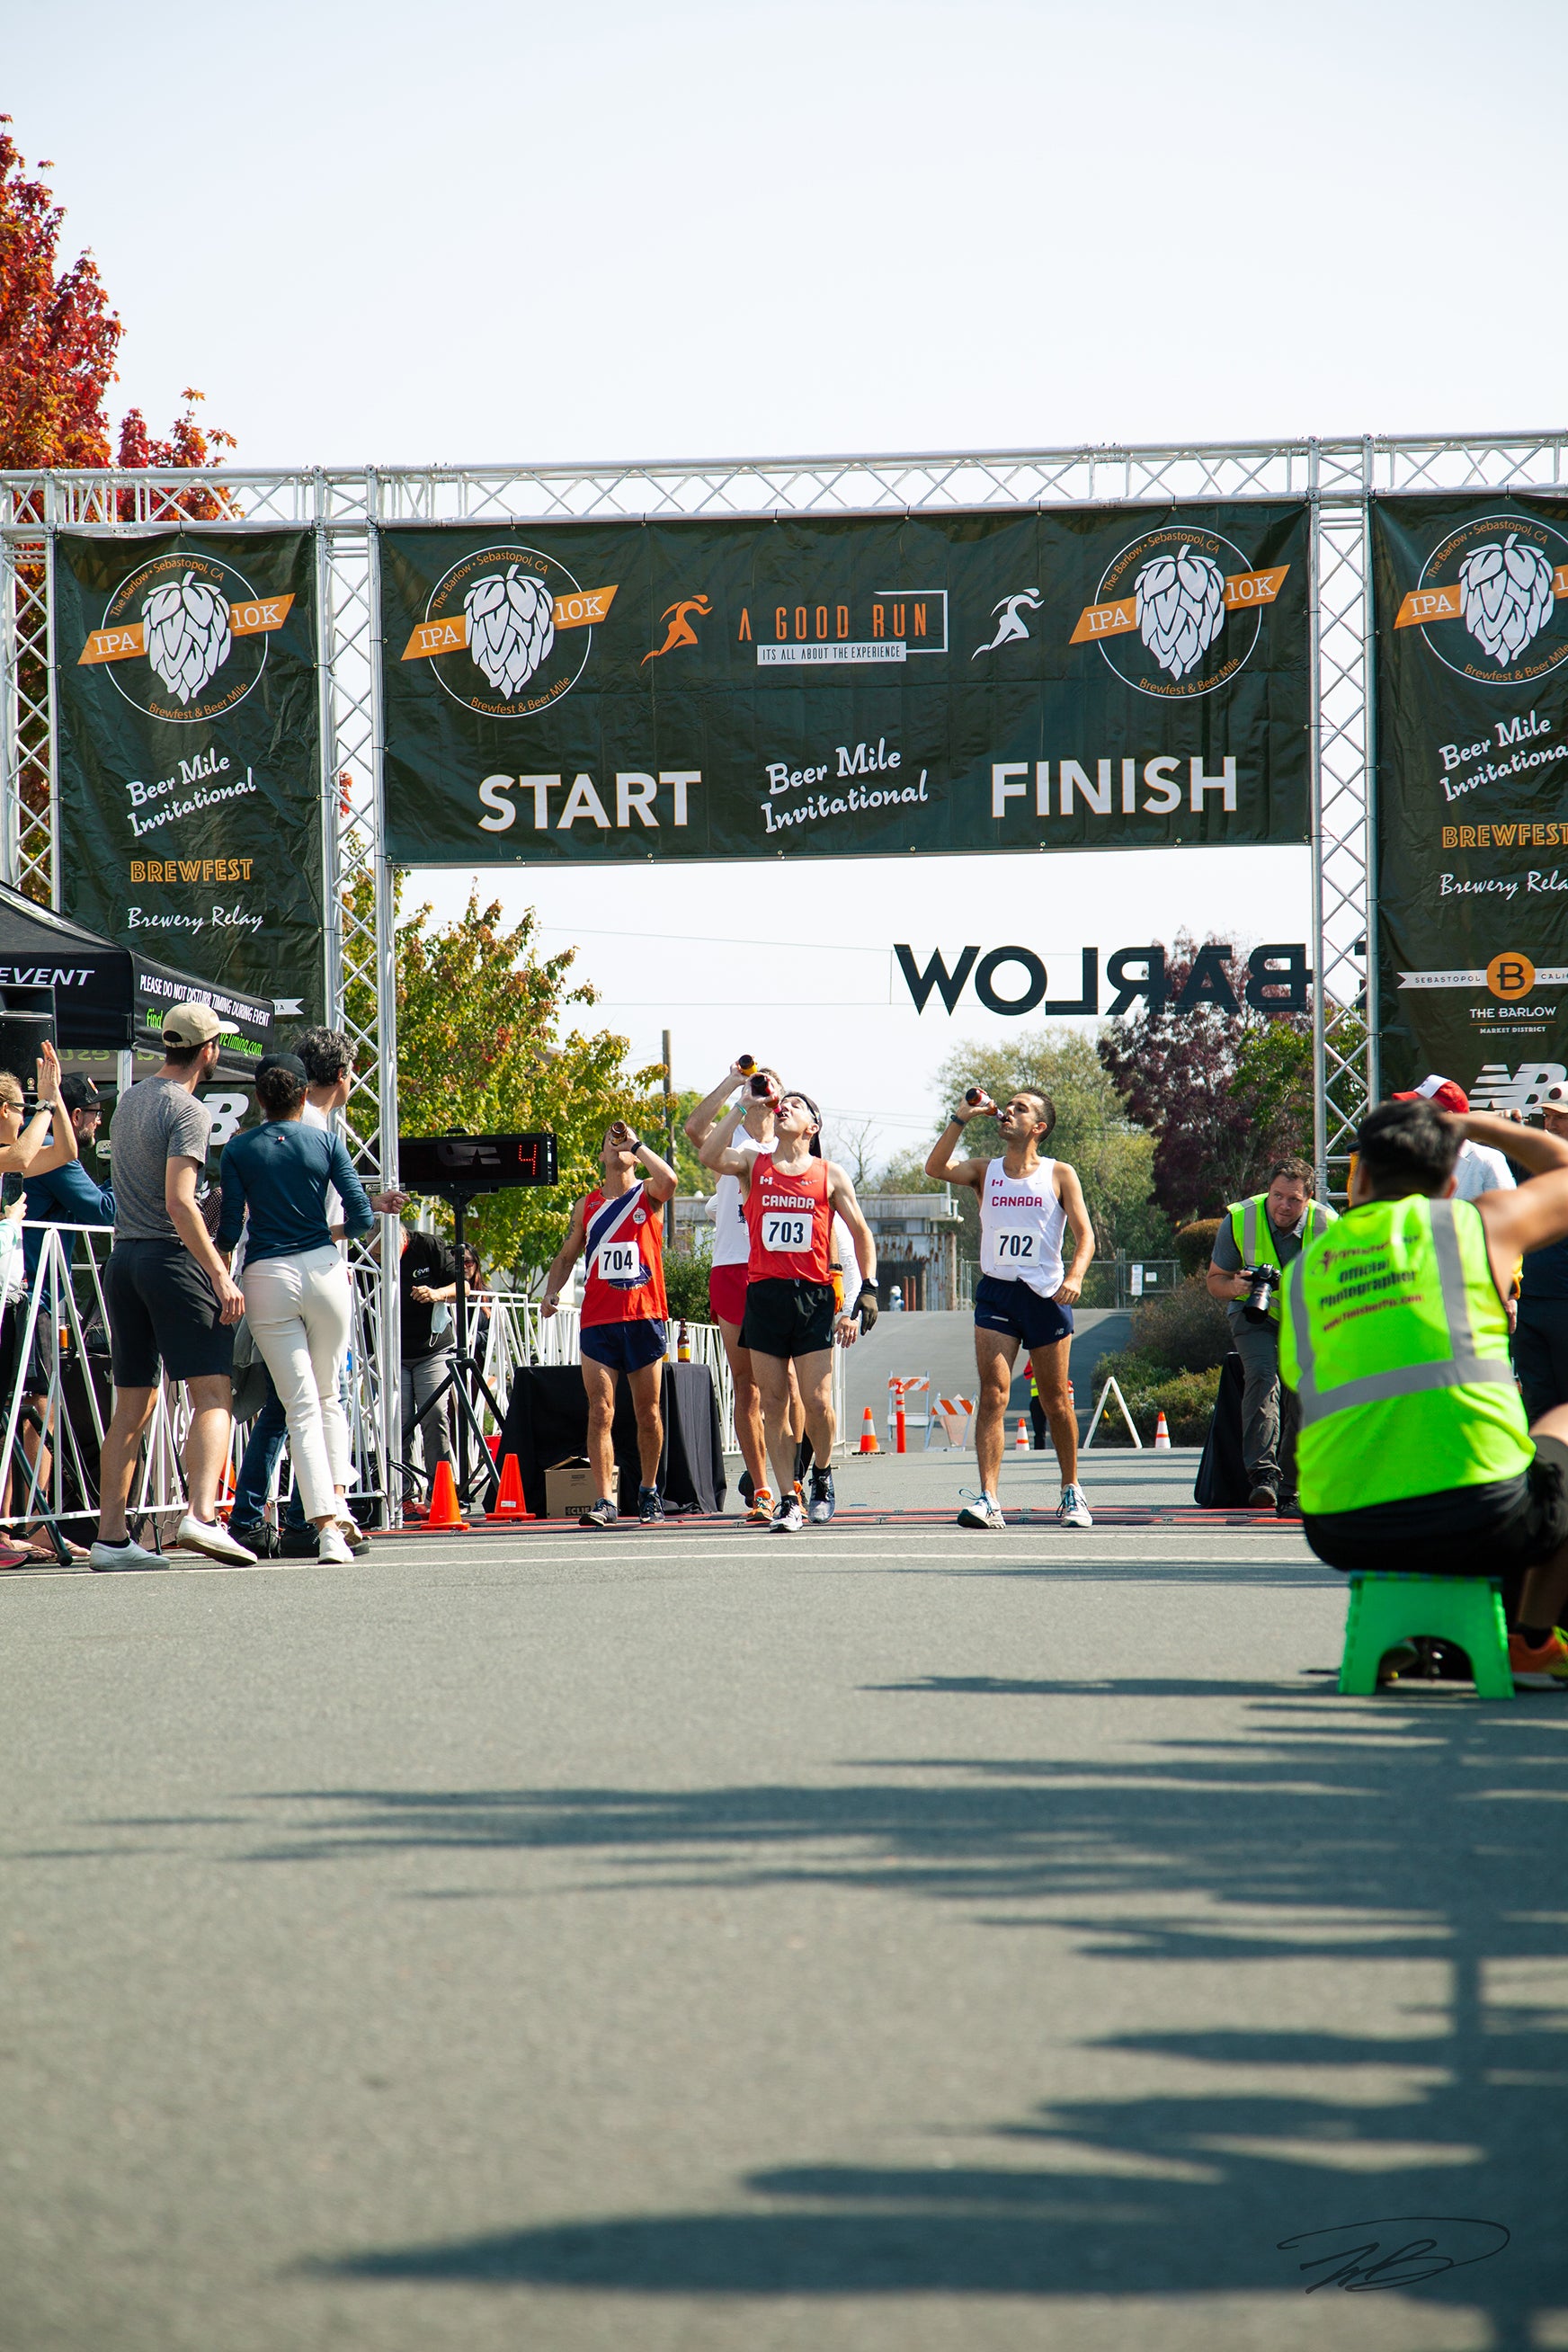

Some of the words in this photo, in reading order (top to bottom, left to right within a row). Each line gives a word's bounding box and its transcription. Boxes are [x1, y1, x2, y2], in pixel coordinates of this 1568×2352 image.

[1103, 574, 1118, 592] The
[1114, 545, 1143, 573] Barlow
[1147, 531, 1205, 548] Sebastopol,
[1206, 539, 1220, 554] CA
[1426, 561, 1443, 578] The
[1439, 534, 1468, 561] Barlow
[1473, 521, 1532, 536] Sebastopol,
[1534, 530, 1548, 544] CA
[110, 599, 126, 618] The
[121, 571, 148, 600] Barlow
[153, 557, 209, 575] Sebastopol,
[209, 566, 225, 582] CA
[432, 593, 448, 609] The
[446, 565, 472, 592] Barlow
[476, 551, 533, 567] Sebastopol,
[534, 558, 549, 575] CA
[418, 626, 460, 649] IPA
[556, 595, 605, 622] 10K
[738, 608, 753, 641] A
[775, 605, 849, 640] GOOD
[873, 602, 926, 637] RUN
[1087, 607, 1130, 632] IPA
[1226, 575, 1276, 602] 10K
[1410, 593, 1455, 618] IPA
[93, 633, 138, 655] IPA
[231, 603, 281, 628] 10K
[762, 648, 777, 661] ITS
[780, 648, 796, 660] ALL
[801, 647, 828, 660] ABOUT
[833, 646, 848, 659] THE
[851, 646, 901, 658] EXPERIENCE
[1464, 664, 1512, 682] Brewfest
[1514, 672, 1524, 681] &
[1525, 661, 1554, 678] Beer
[1139, 678, 1185, 695] Brewfest
[1188, 684, 1196, 693] &
[1197, 673, 1220, 690] Beer
[1219, 657, 1241, 679] Mile
[148, 702, 193, 719] Brewfest
[194, 707, 203, 718] &
[203, 699, 227, 717] Beer
[226, 682, 248, 707] Mile
[470, 697, 516, 714] Brewfest
[518, 703, 527, 713] &
[527, 693, 551, 710] Beer
[550, 677, 571, 699] Mile
[1439, 738, 1492, 771] Beer
[1494, 709, 1552, 747] Mile
[126, 780, 175, 806] Beer
[178, 747, 230, 784] Mile
[765, 762, 829, 797] Beer
[835, 736, 902, 779] Mile
[1439, 743, 1568, 802] Invitationa
[127, 766, 256, 837] Invitational
[477, 770, 701, 832] START
[761, 769, 929, 834] Invitational
[992, 755, 1237, 818] FINISH
[1442, 823, 1568, 848] BREWFEST
[130, 859, 253, 883] BREWFEST
[1439, 873, 1519, 901] Brewery
[1527, 869, 1568, 893] Rela
[127, 907, 204, 935] Brewery
[211, 905, 263, 932] Relay
[0, 967, 95, 985] EVENT
[1415, 976, 1481, 984] SEBASTOPOL
[140, 975, 162, 994] PLEASE
[162, 982, 173, 998] DO
[173, 983, 186, 1001] NOT
[186, 987, 212, 1006] DISTURB
[211, 993, 232, 1014] TIMING
[232, 1001, 253, 1022] DURING
[252, 1009, 270, 1027] EVENT
[146, 1008, 163, 1029] Find
[1469, 1008, 1495, 1019] THE
[1499, 1006, 1556, 1018] BARLOW
[219, 1032, 263, 1056] VETiming.com
[519, 1144, 537, 1176] 4
[762, 1195, 815, 1209] CANADA
[992, 1196, 1043, 1207] CANADA
[769, 1221, 804, 1243] 703
[999, 1234, 1033, 1257] 702
[603, 1250, 633, 1271] 704
